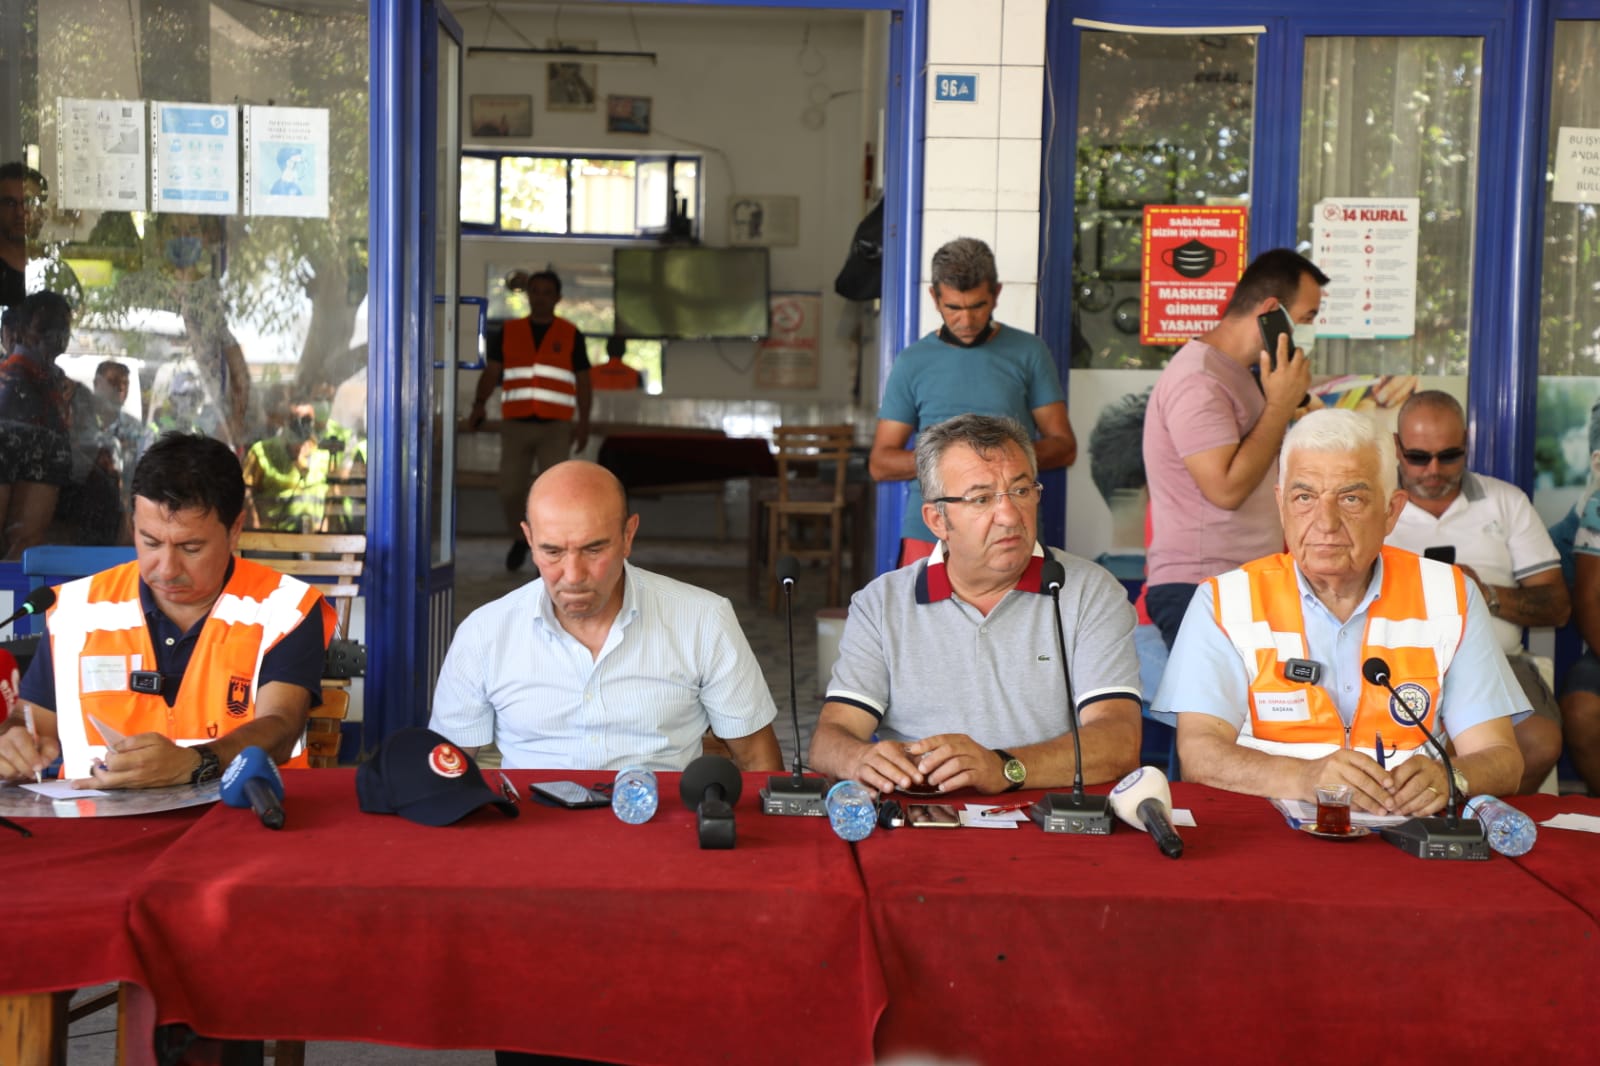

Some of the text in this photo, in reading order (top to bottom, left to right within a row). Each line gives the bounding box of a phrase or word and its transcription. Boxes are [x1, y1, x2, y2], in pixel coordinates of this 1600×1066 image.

[1343, 209, 1408, 222] 14 KURAL
[1158, 286, 1227, 300] MASKESİZ
[1165, 301, 1219, 316] GİRMEK
